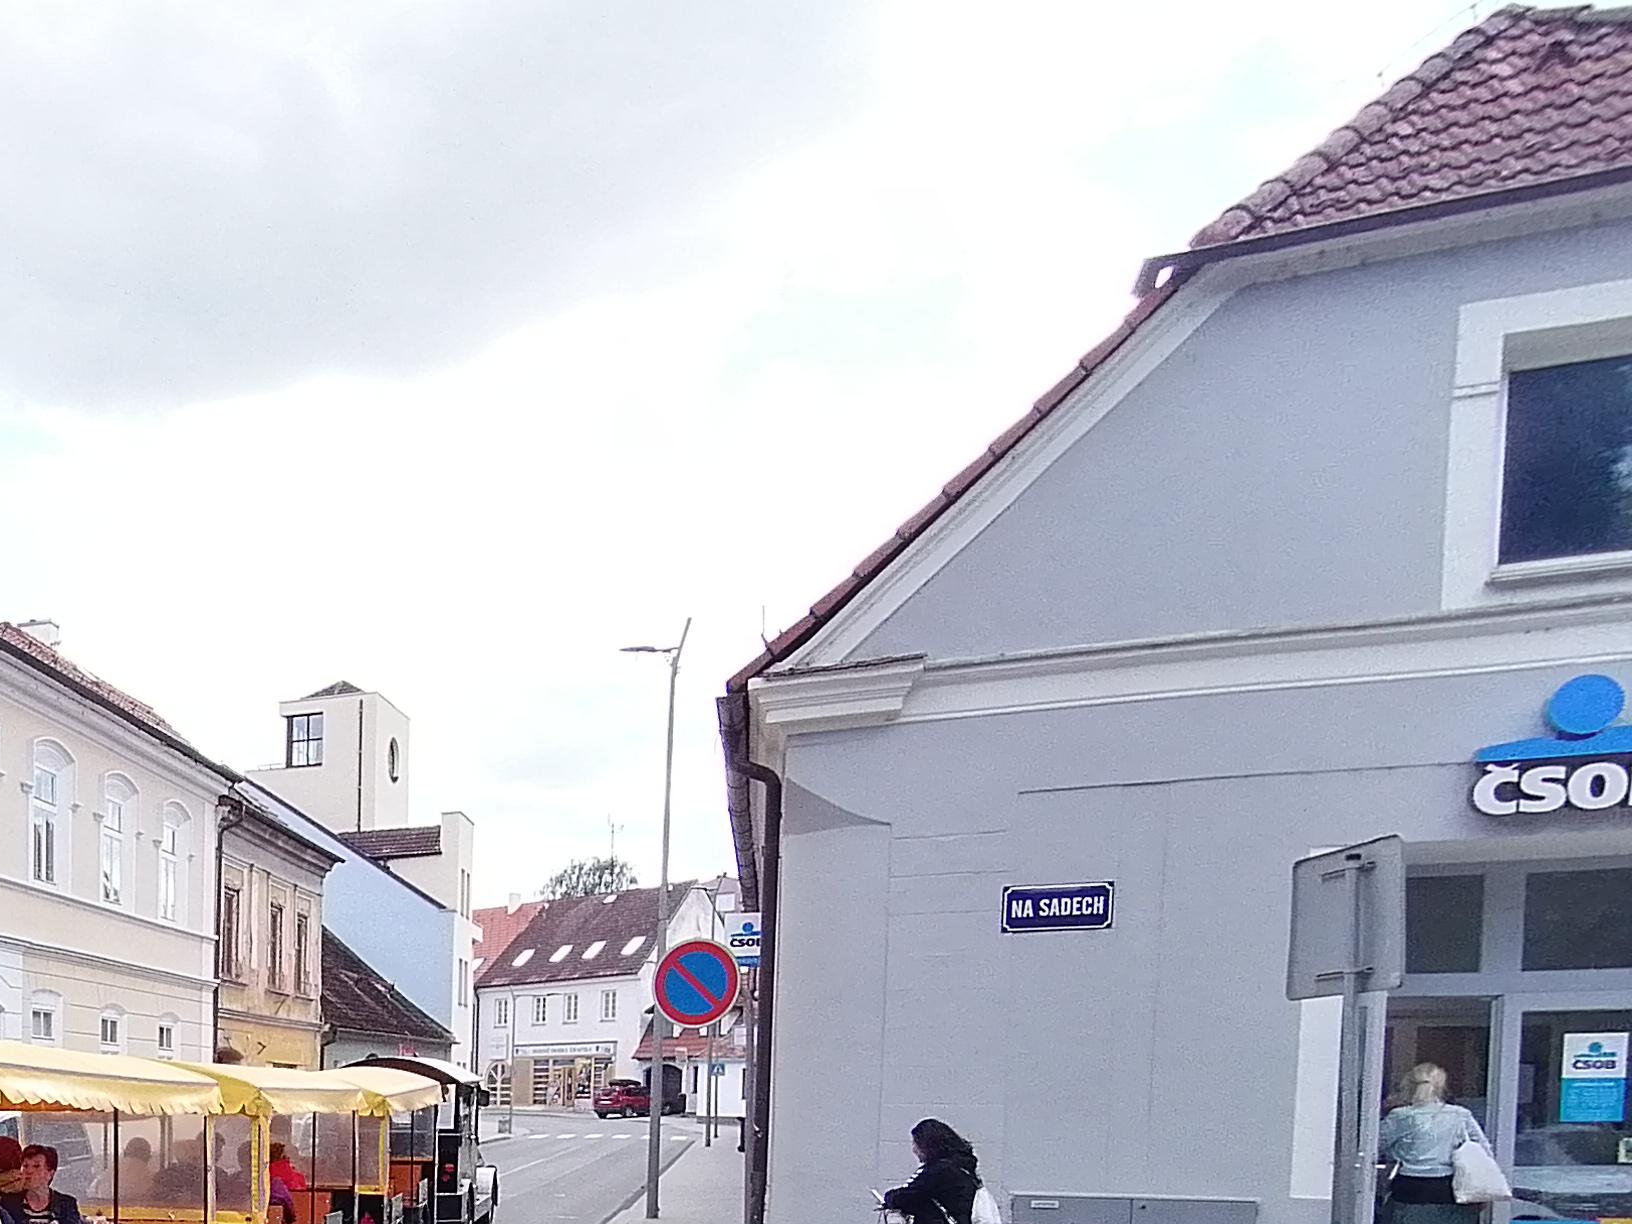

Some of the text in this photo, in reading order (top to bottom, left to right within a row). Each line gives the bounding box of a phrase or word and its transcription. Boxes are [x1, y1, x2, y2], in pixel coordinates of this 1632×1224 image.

[1473, 761, 1632, 816] ČSO
[1011, 896, 1105, 918] NA SADECH
